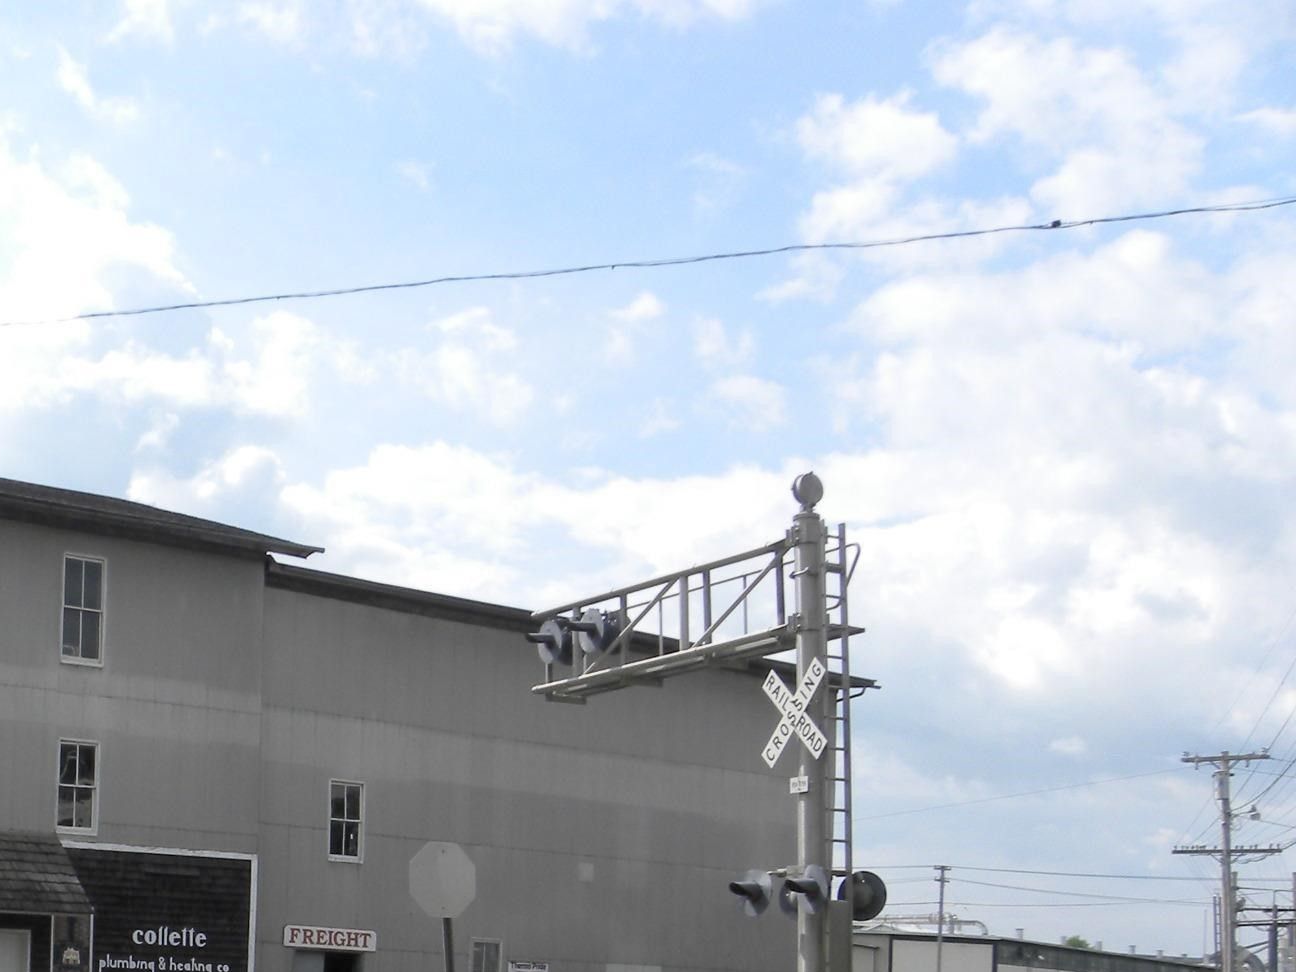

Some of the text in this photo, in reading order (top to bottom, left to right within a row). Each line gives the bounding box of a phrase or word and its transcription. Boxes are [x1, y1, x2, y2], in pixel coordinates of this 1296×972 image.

[766, 663, 822, 762] CROSSING
[132, 925, 207, 948] collette
[288, 927, 372, 949] FREIGHT
[157, 956, 167, 971] &
[216, 964, 230, 972] co
